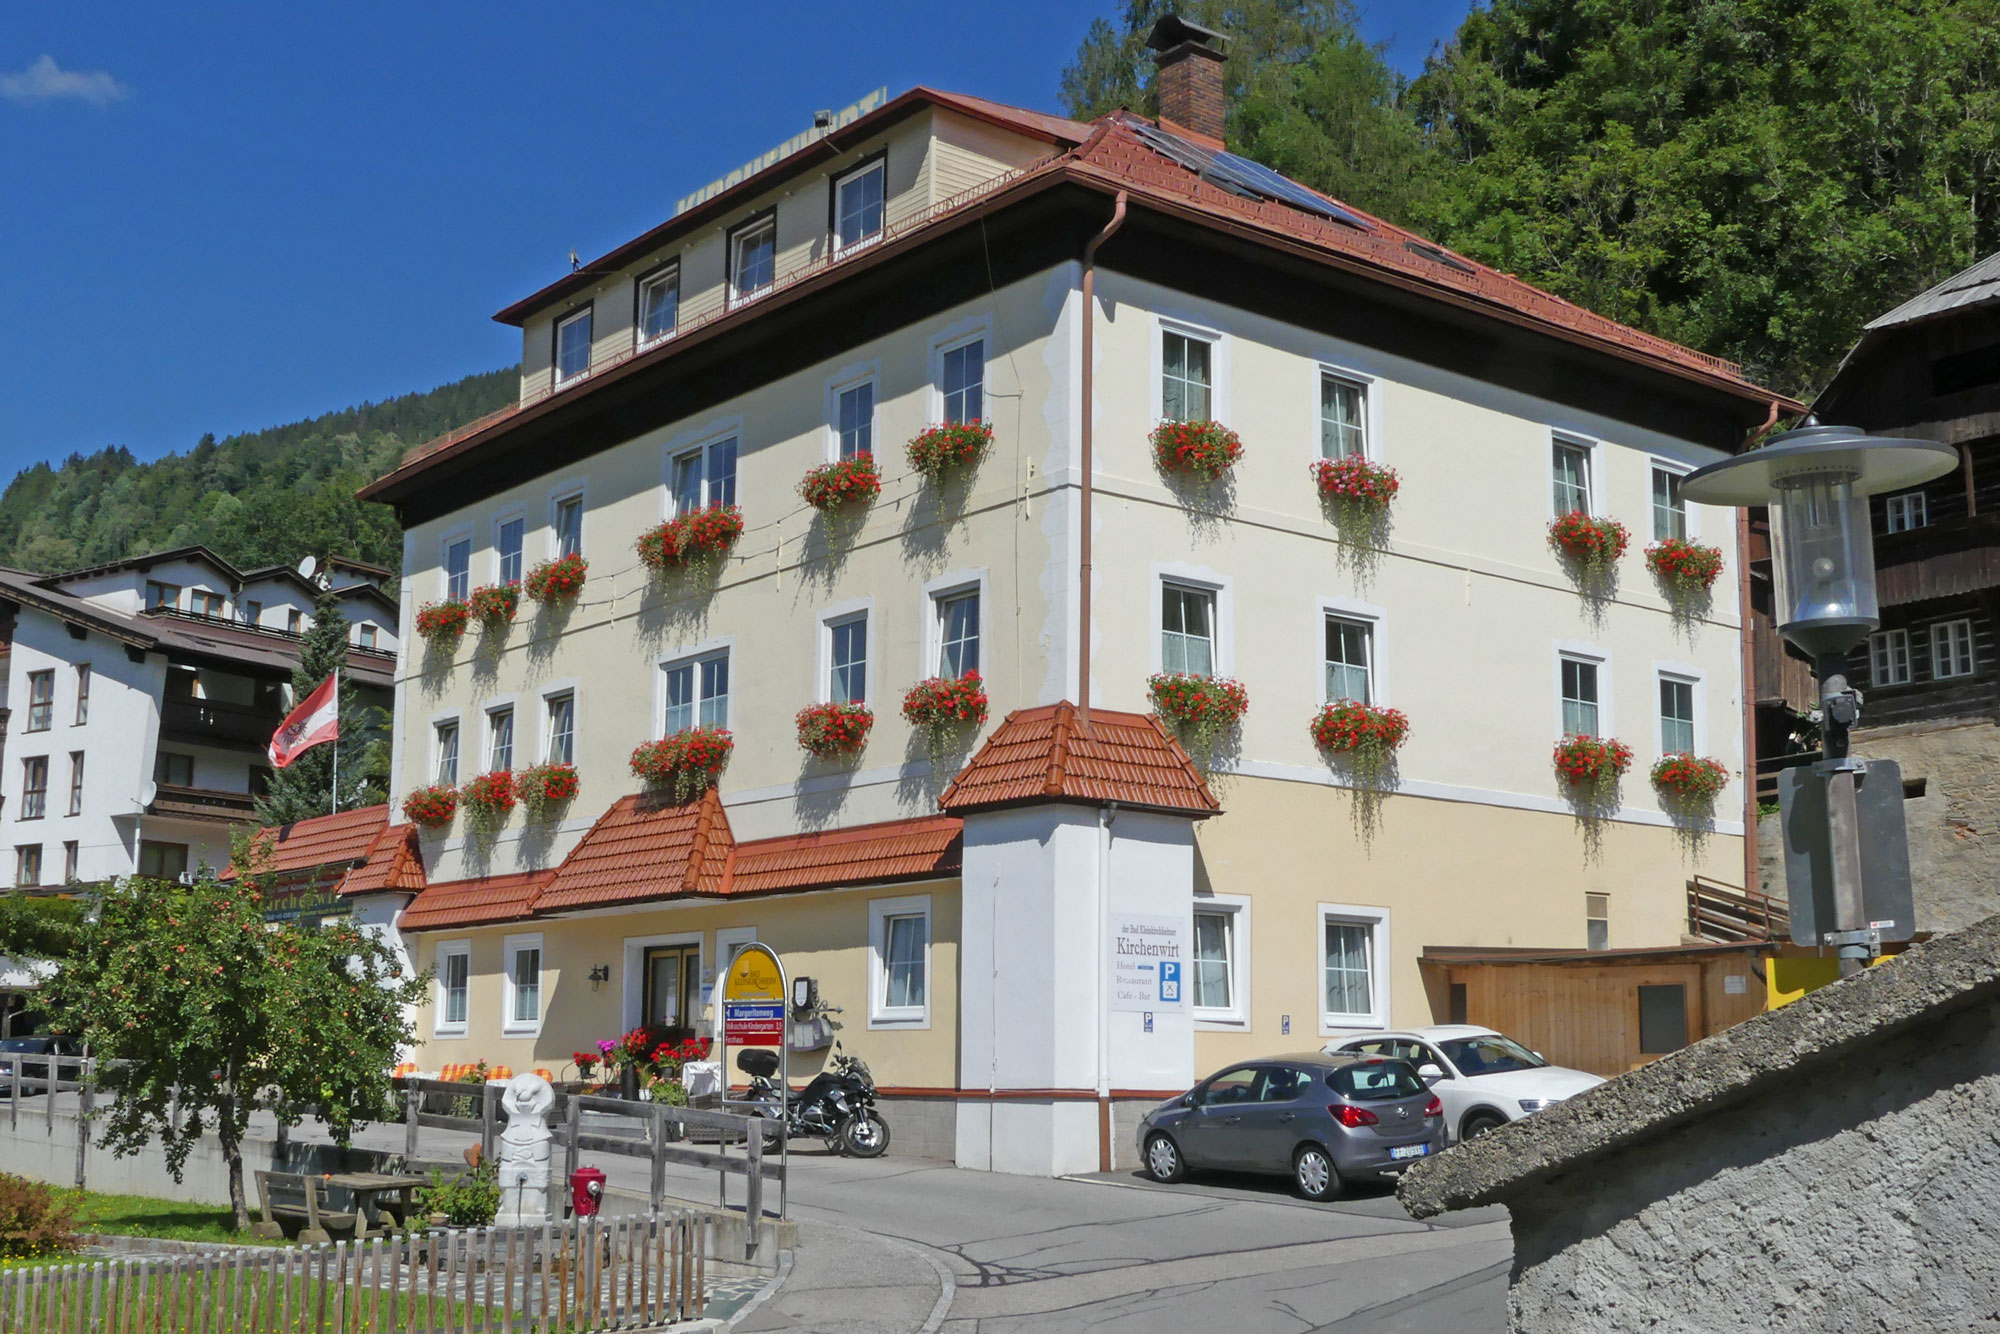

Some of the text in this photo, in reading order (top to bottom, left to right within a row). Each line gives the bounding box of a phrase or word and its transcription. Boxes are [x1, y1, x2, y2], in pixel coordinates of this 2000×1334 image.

[1116, 937, 1180, 957] Kirchenwirt
[1117, 961, 1136, 970] Hotel
[1165, 963, 1175, 980] P
[1139, 991, 1151, 1000] Bar
